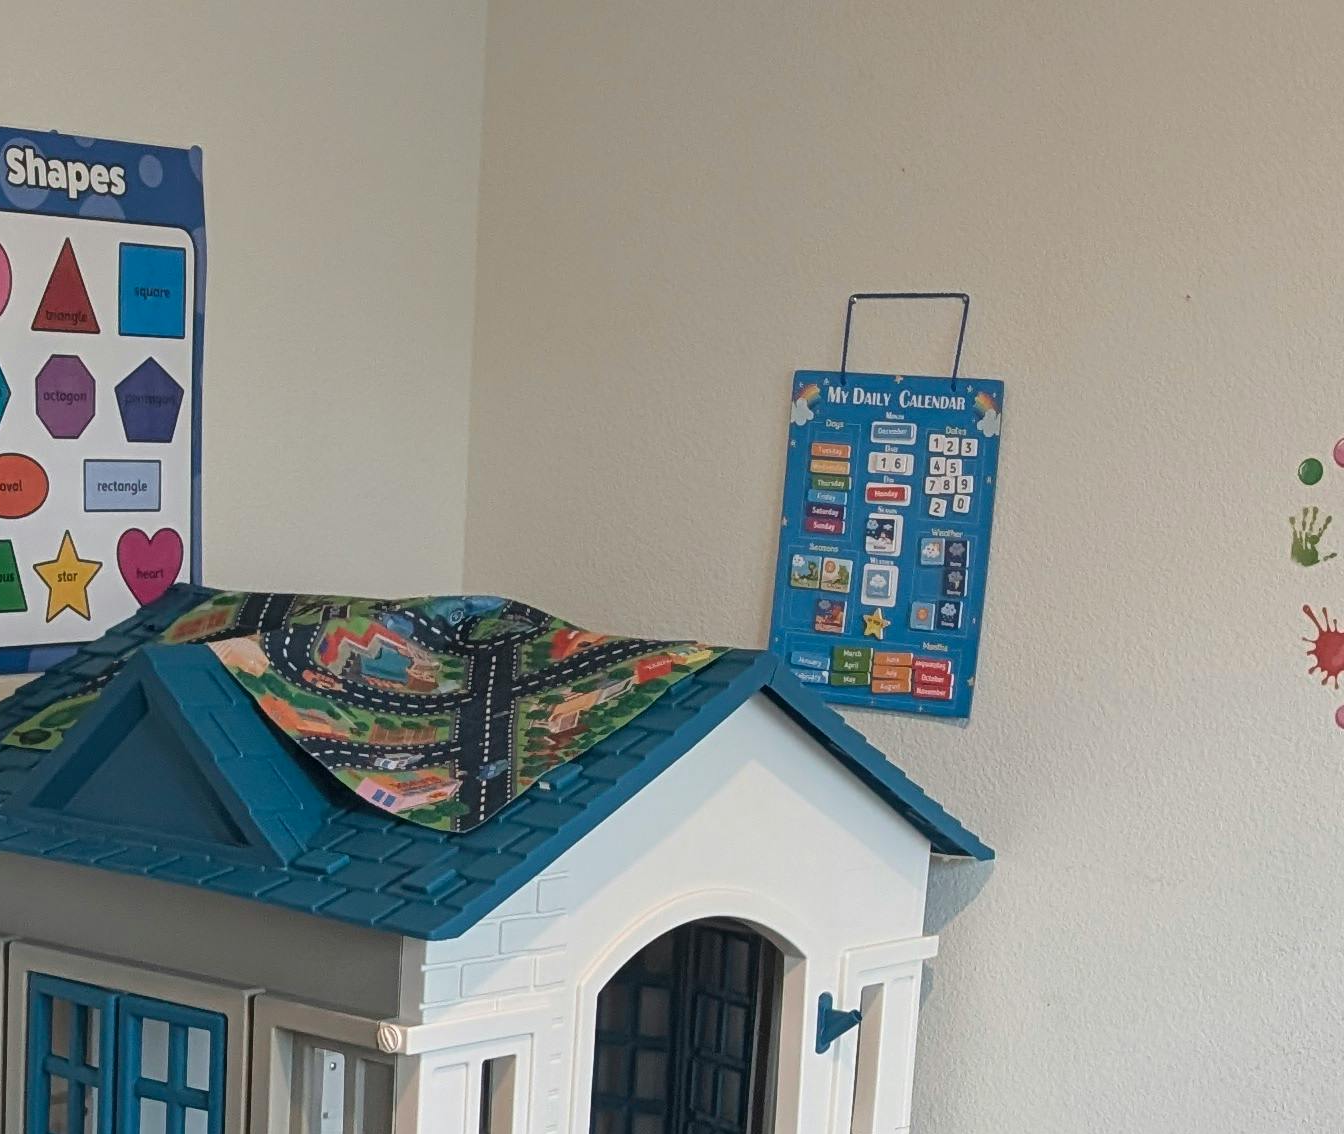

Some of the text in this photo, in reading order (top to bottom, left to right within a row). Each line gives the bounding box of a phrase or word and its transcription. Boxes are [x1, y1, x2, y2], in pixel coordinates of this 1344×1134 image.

[6, 147, 126, 199] Shapes
[134, 286, 171, 300] square
[43, 390, 87, 405] octagon
[0, 480, 23, 492] oval
[97, 480, 148, 493] rectangle
[57, 570, 78, 582] star
[136, 567, 164, 580] heart
